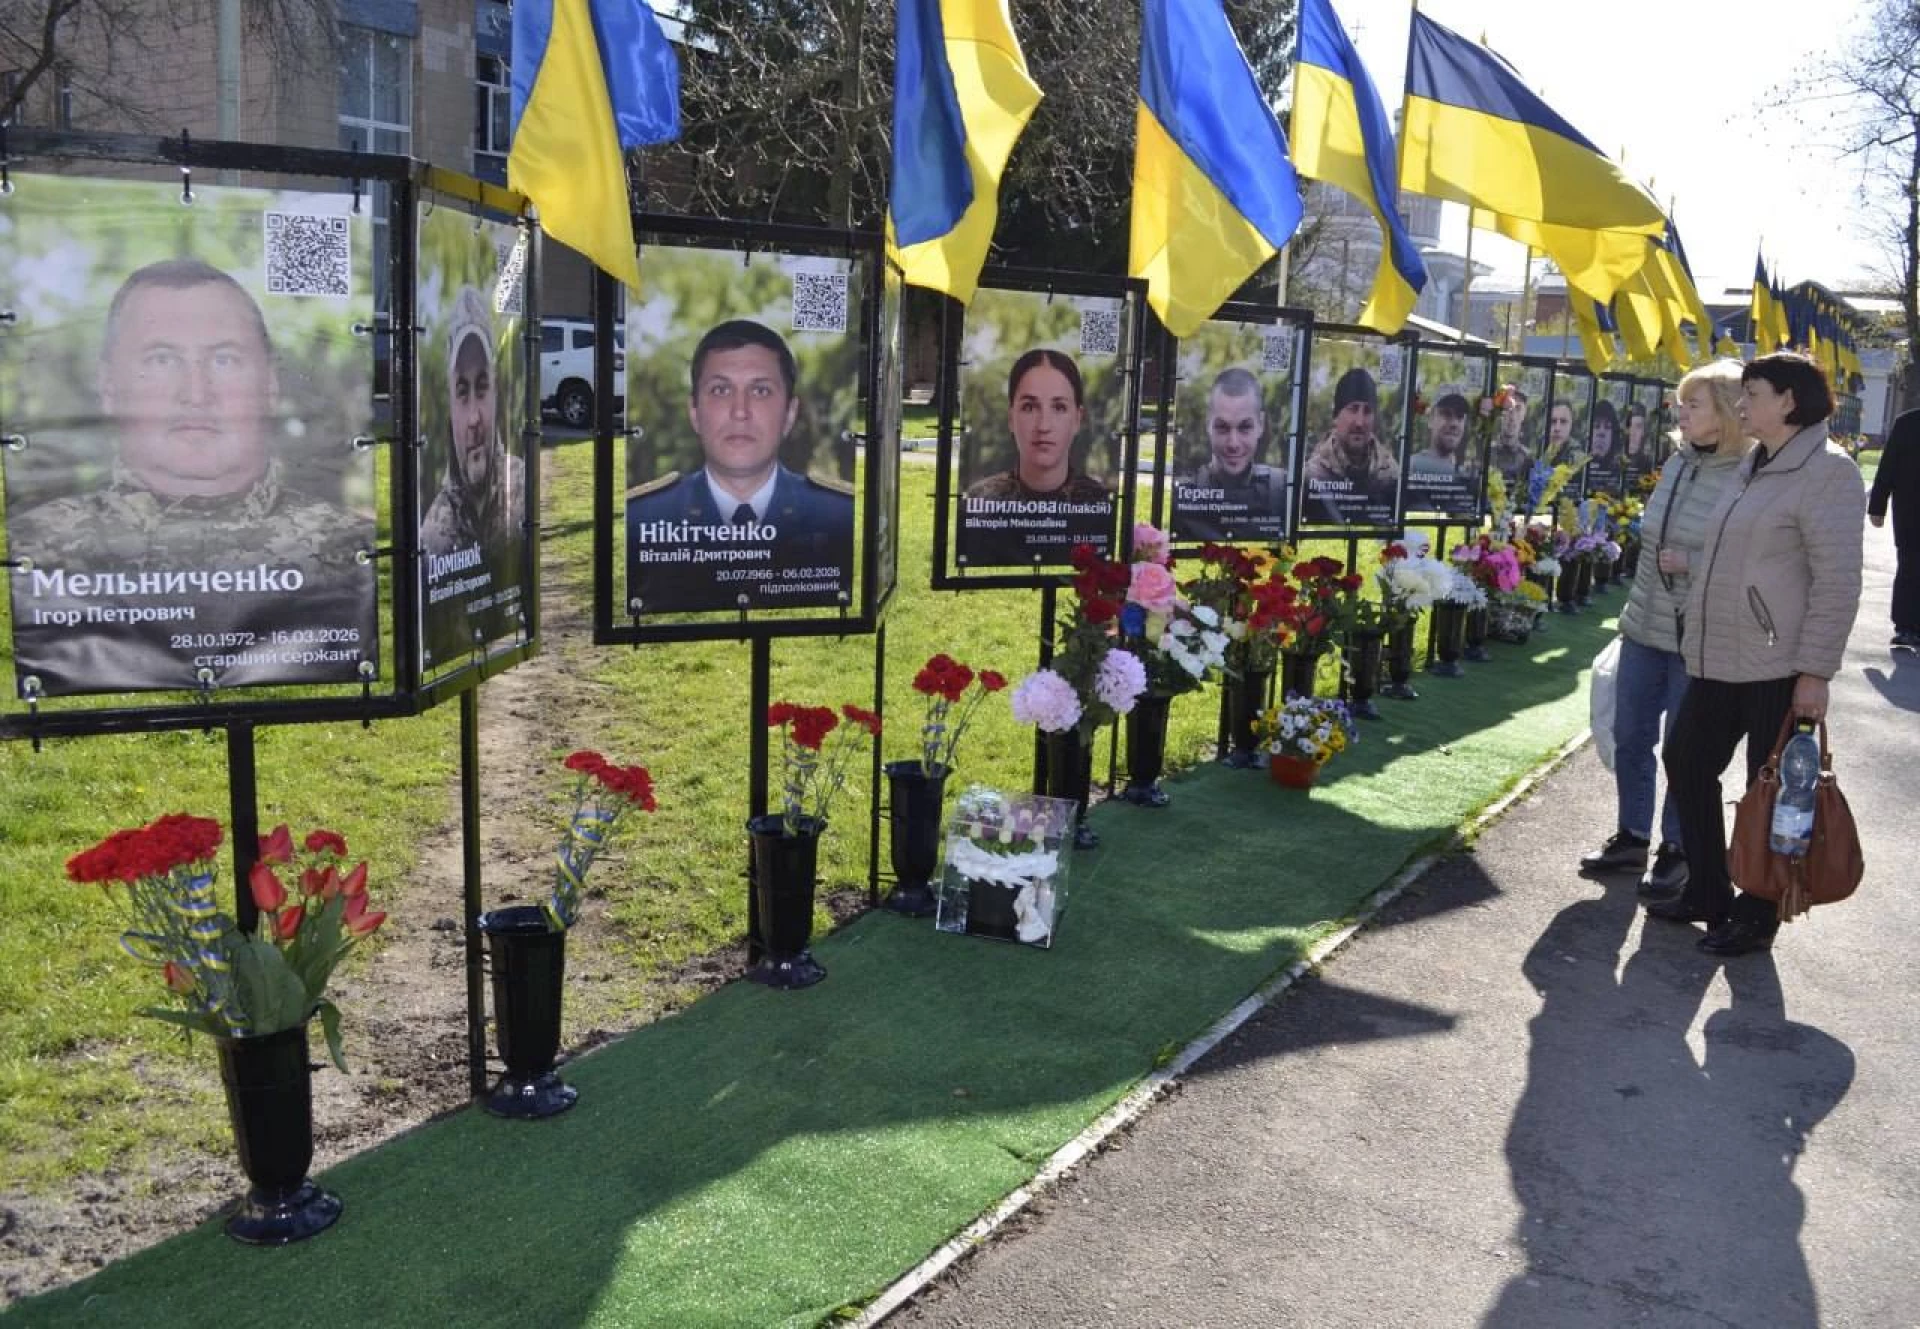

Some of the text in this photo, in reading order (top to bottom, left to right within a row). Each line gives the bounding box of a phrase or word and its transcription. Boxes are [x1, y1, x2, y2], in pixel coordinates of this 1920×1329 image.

[965, 497, 1112, 515] Шпильова (Плаксій)
[639, 519, 777, 543] Нікітченко
[428, 541, 481, 584] Домінюк
[639, 548, 771, 564] Віталій Дмитрович
[32, 563, 304, 597] Мельниченко
[716, 568, 774, 582] 20.07.1966
[782, 566, 841, 580] 06.02.2026
[760, 580, 841, 594] підполковник
[35, 605, 196, 627] Ігор Петрович
[170, 632, 255, 649] 28.10.1972
[271, 628, 359, 645] 16.03.2026
[194, 647, 361, 668] старший сержант
